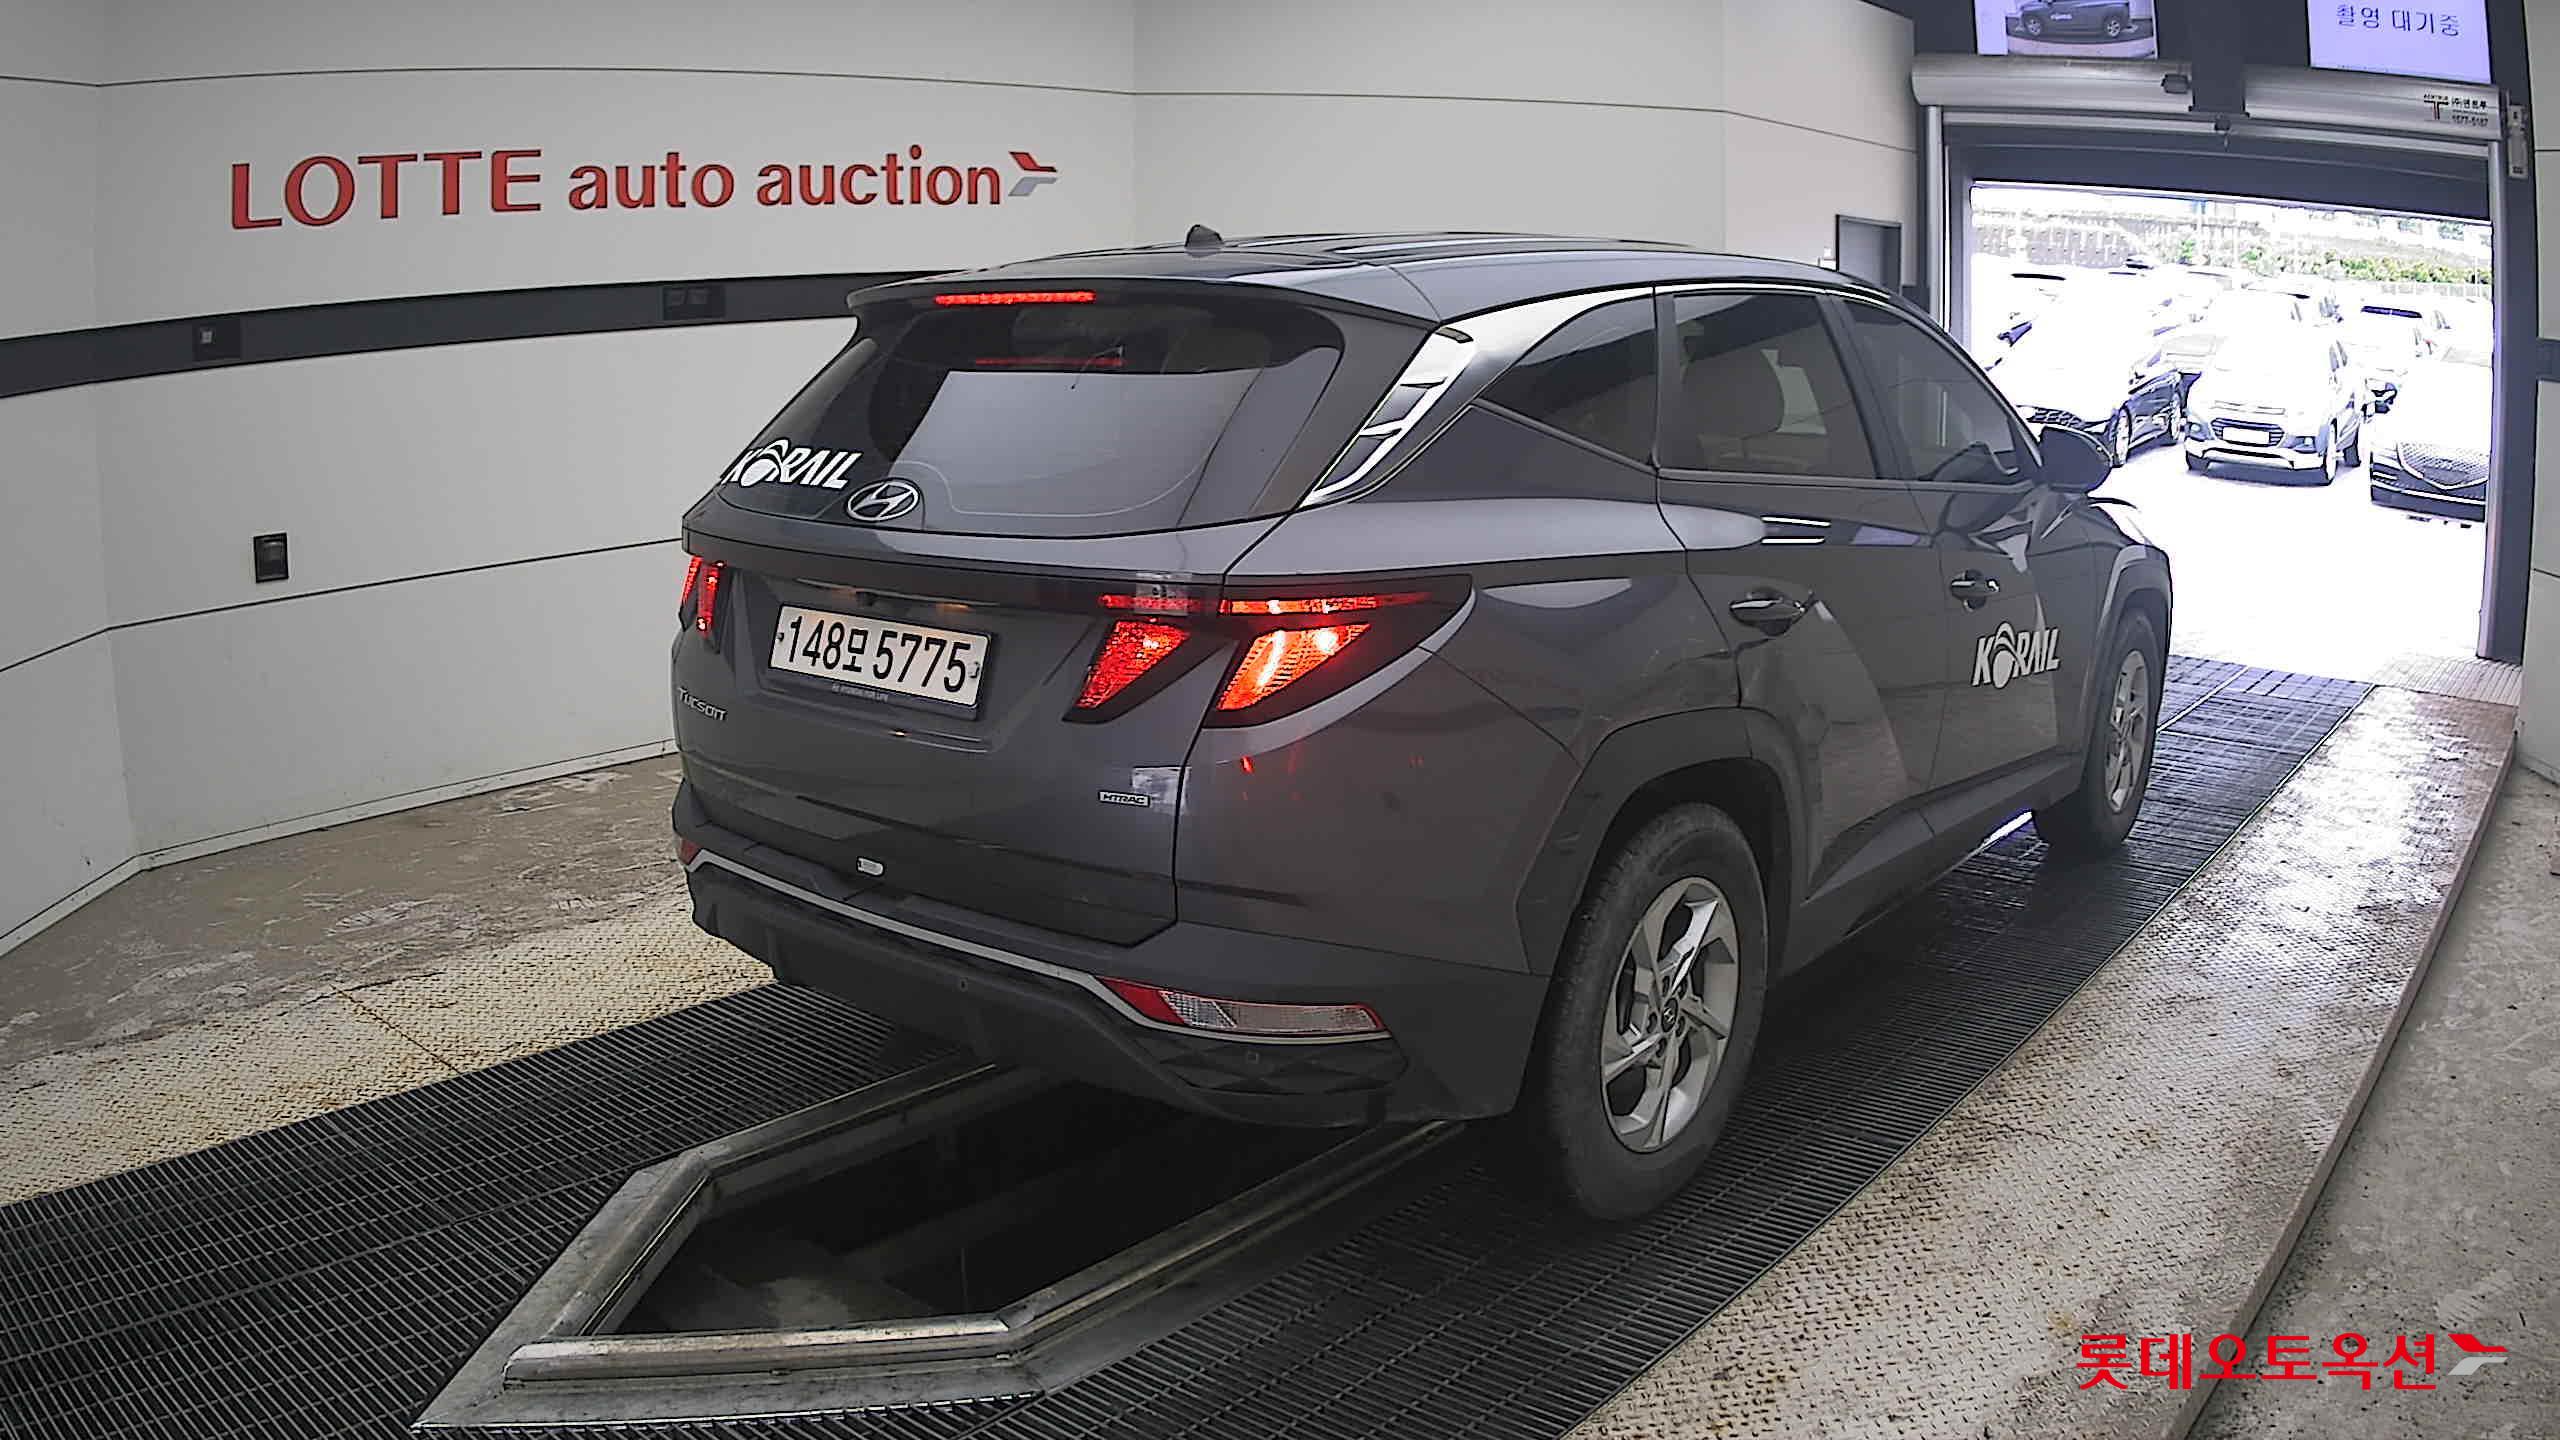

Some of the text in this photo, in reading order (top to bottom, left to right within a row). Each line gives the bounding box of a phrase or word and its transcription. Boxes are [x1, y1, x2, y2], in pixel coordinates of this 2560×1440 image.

[2336, 4, 2459, 37] 촬영 대기중
[230, 144, 1003, 231] LOTTE auto auction
[720, 439, 863, 489] KORAIL
[790, 615, 972, 693] 148모 5775
[1971, 621, 2060, 688] KORAIL
[678, 686, 728, 721] TUCSON
